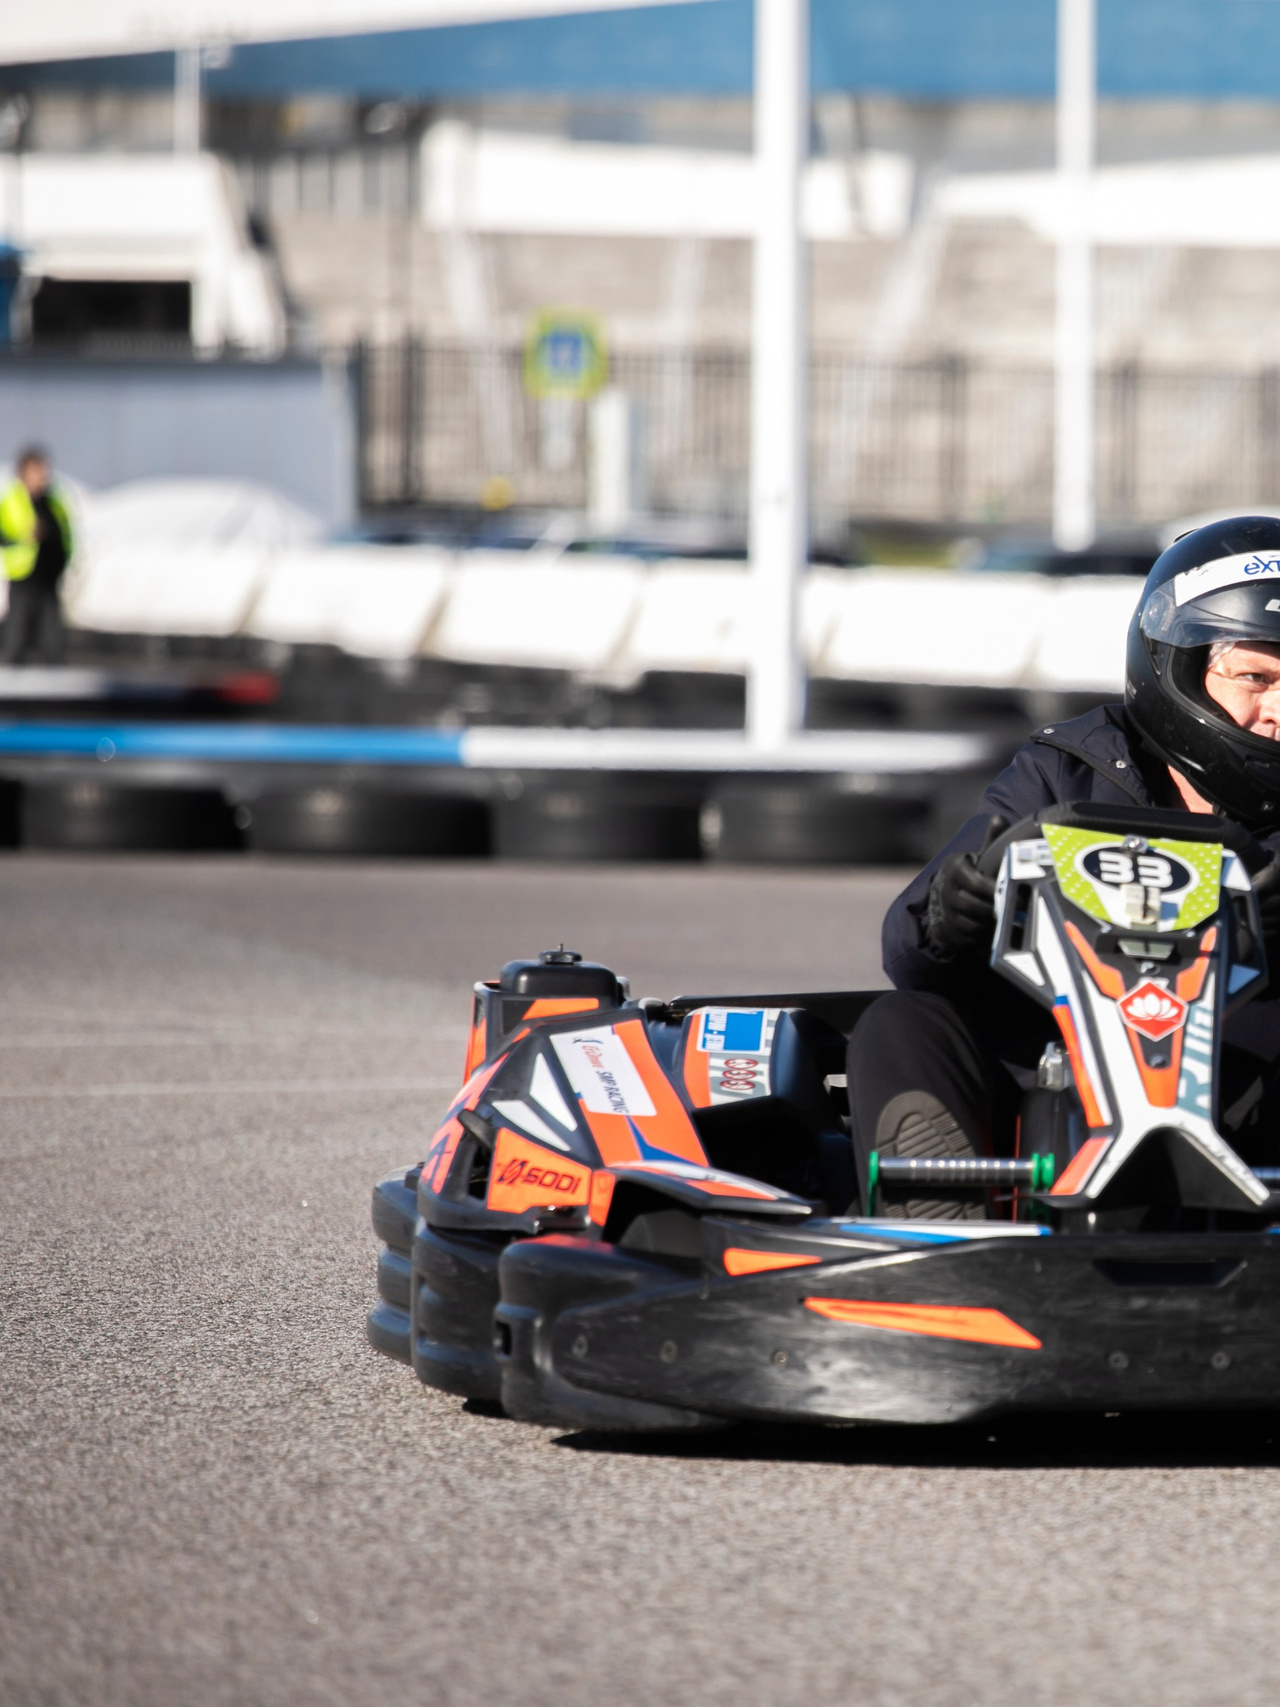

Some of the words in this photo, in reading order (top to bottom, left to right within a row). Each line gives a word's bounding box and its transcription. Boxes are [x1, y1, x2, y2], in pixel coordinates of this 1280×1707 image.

[1099, 851, 1173, 888] 33
[603, 1085, 630, 1114] RACING
[522, 1167, 582, 1195] SODI
